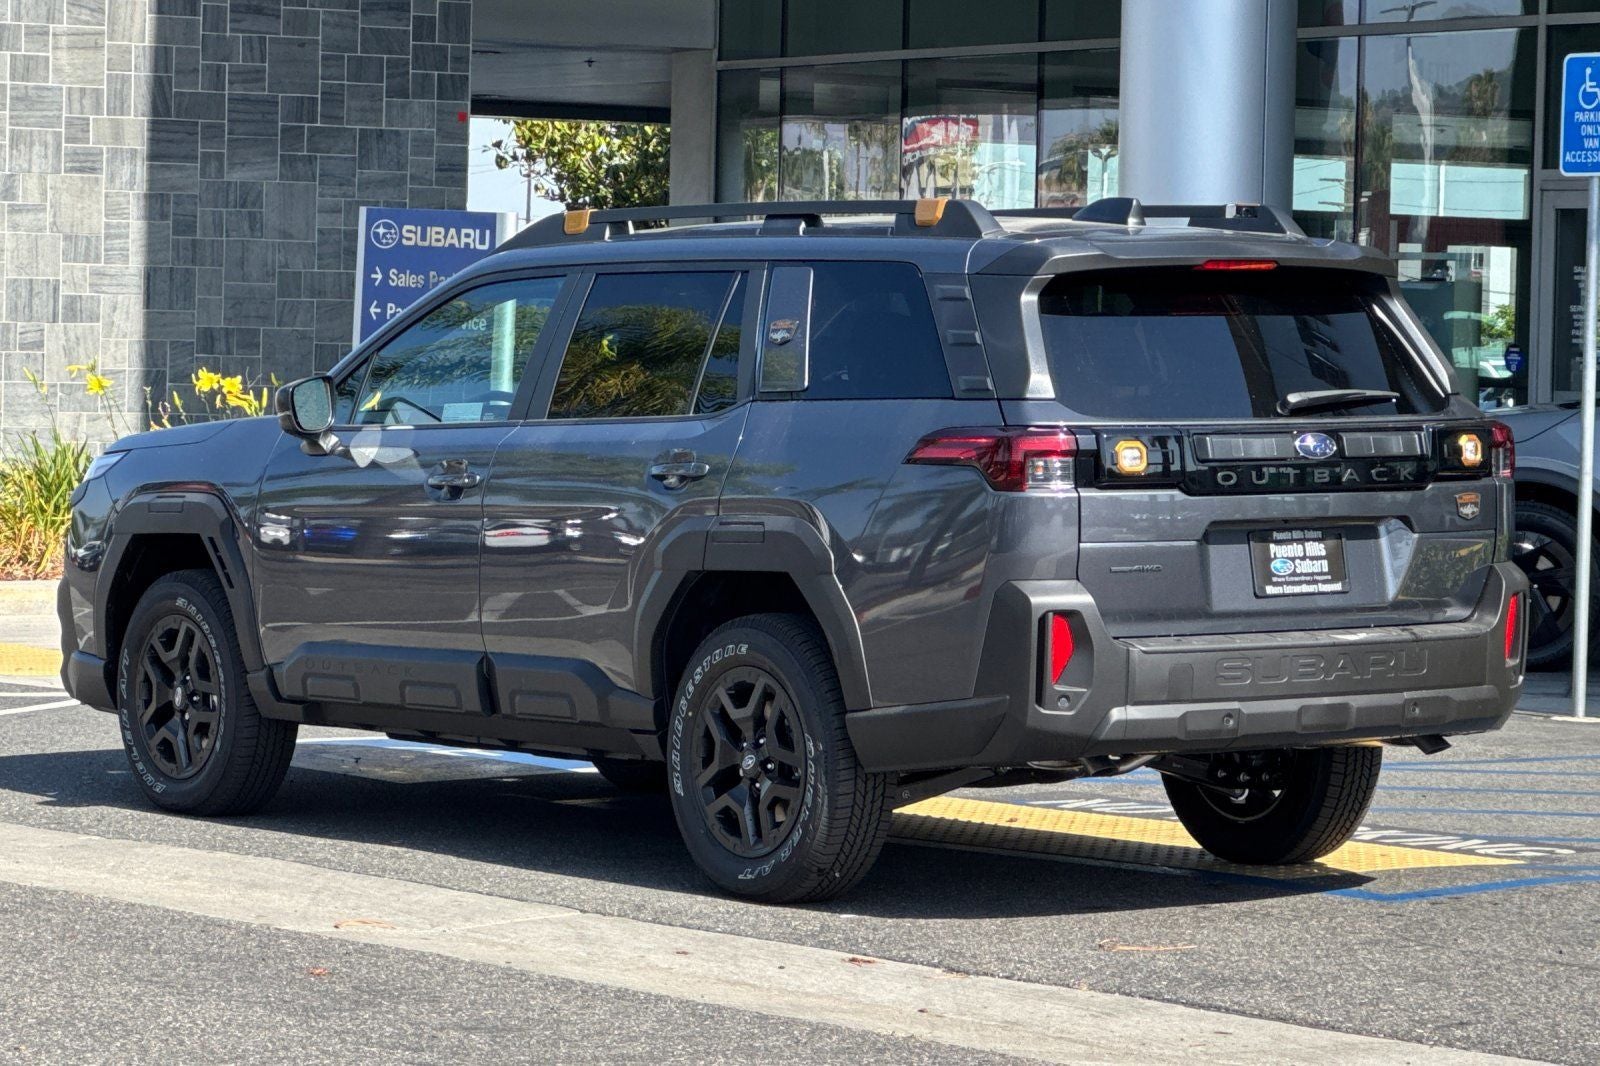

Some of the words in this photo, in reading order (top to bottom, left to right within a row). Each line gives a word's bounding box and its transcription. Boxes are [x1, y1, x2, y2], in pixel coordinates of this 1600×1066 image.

[1584, 137, 1599, 149] VAN
[1565, 151, 1600, 163] ACCESSI
[401, 224, 490, 250] SUBARU
[388, 267, 425, 289] Sales
[1216, 467, 1415, 486] OUTBACK
[1269, 543, 1304, 558] Puente
[1305, 541, 1326, 556] Hills
[1295, 559, 1328, 573] Subaru
[1214, 651, 1429, 687] SUBARU
[668, 643, 749, 797] BRIDGESTONE
[737, 863, 777, 881] A/T
